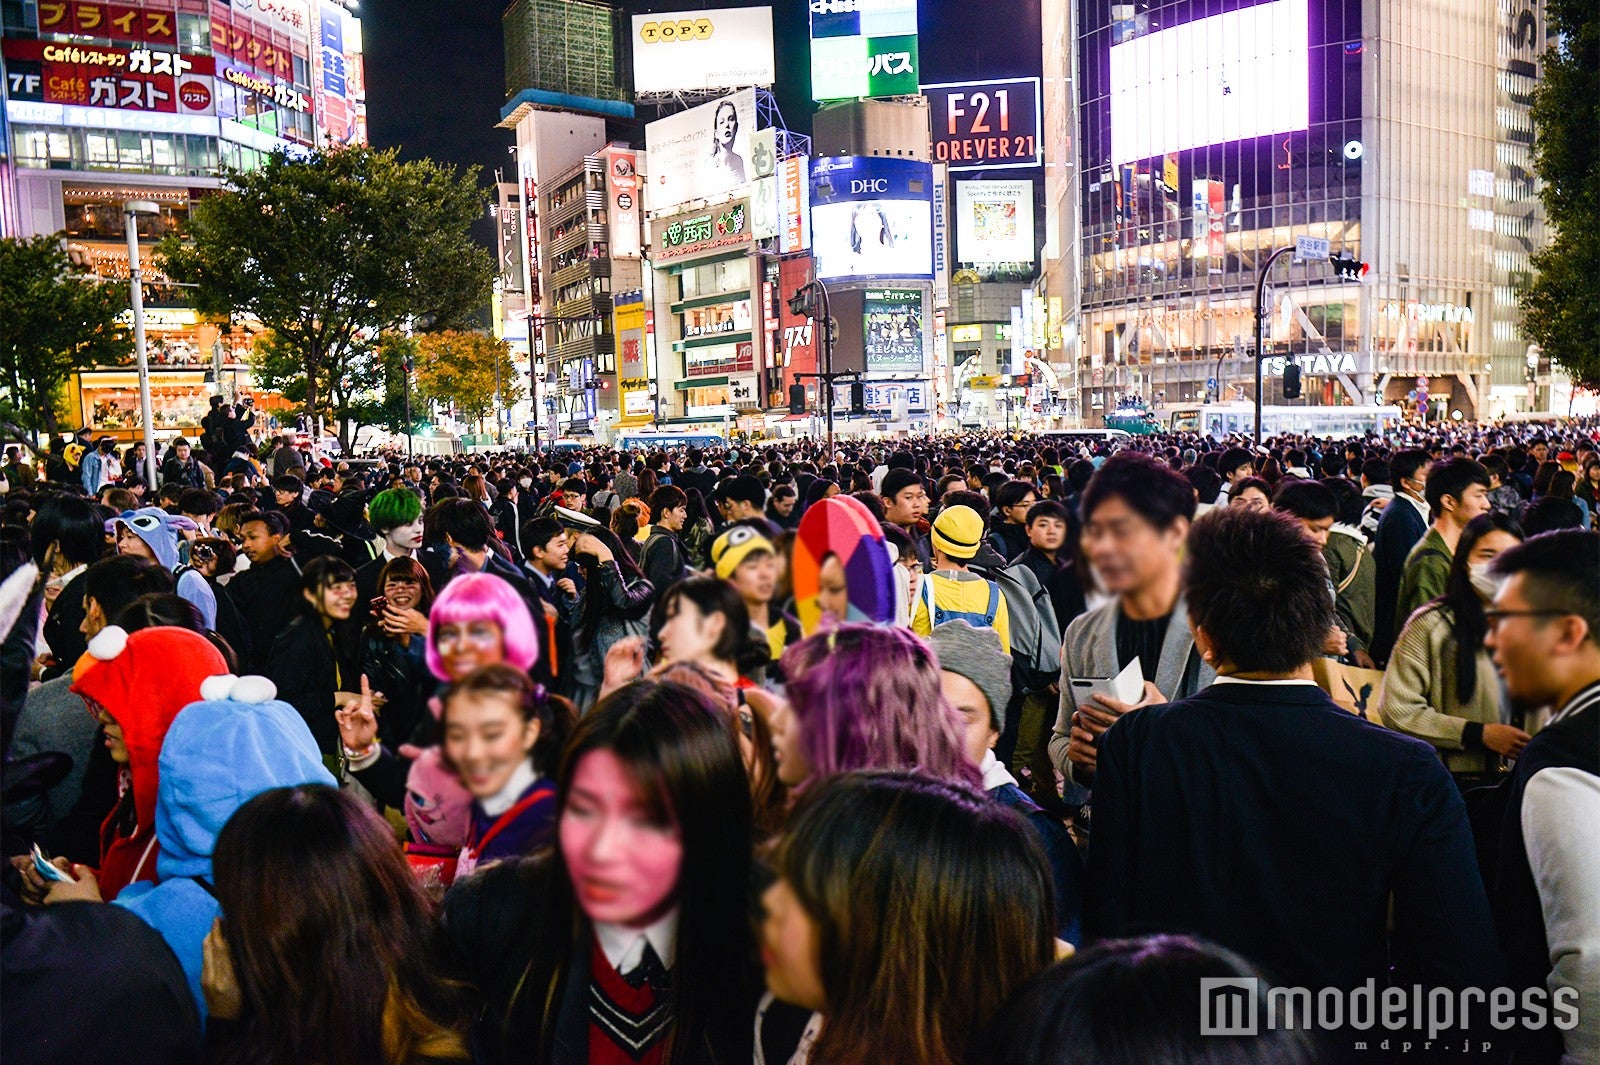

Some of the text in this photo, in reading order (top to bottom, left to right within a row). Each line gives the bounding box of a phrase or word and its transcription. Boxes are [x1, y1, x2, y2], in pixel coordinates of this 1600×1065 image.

[40, 3, 173, 36] プライス
[646, 24, 708, 37] TOPY
[212, 22, 290, 72] コンタクト
[128, 48, 193, 76] ガスト
[8, 73, 41, 94] 7F
[49, 76, 86, 92] Café
[90, 76, 169, 109] ガスト
[183, 93, 208, 103] ガスト
[274, 84, 310, 112] ガスト
[948, 89, 1009, 135] F21
[1015, 136, 1034, 157] 21
[851, 179, 887, 193] DHC
[683, 222, 712, 244] 西村
[935, 181, 945, 272] Taisei neon
[1408, 303, 1473, 322] TSUTAYA
[738, 345, 752, 359] JTB
